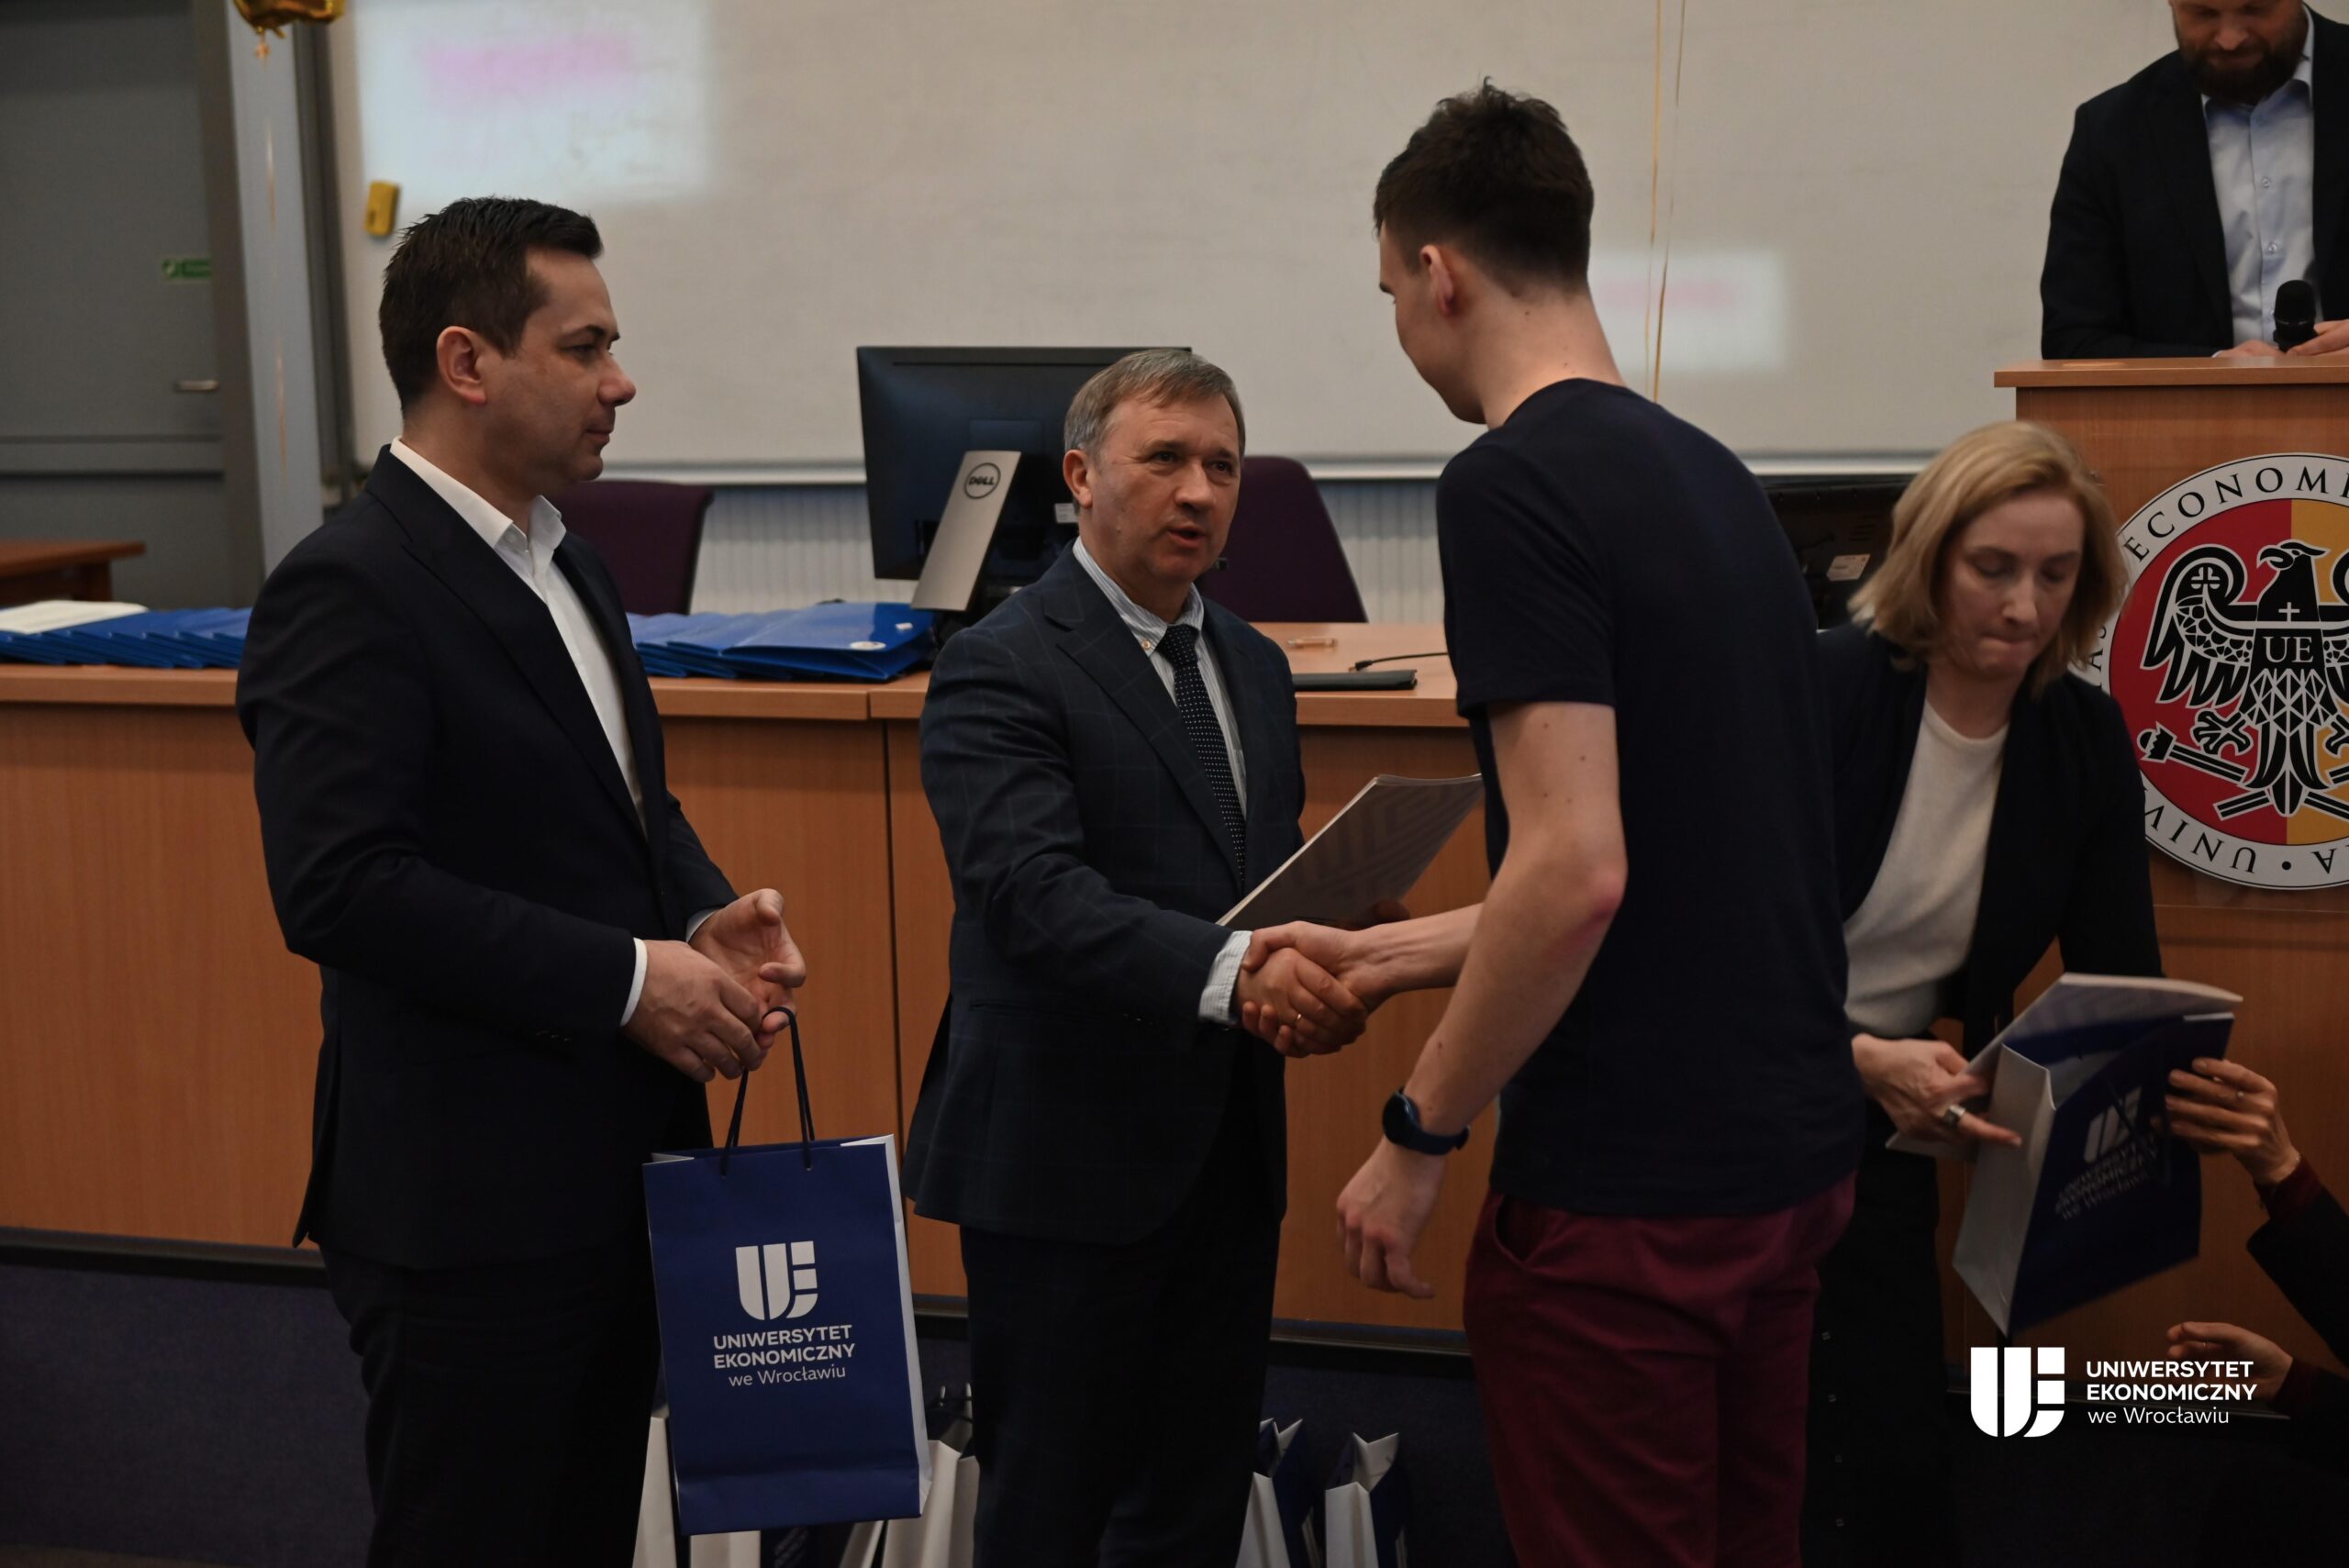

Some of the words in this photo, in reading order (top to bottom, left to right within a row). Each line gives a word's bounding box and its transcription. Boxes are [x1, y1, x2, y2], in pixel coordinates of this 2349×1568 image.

[2262, 636, 2313, 663] UE
[713, 1324, 852, 1350] UNIWERSYTET
[713, 1343, 855, 1369] EKONOMICZNY
[729, 1374, 753, 1387] we
[757, 1363, 846, 1385] Wrocławiu
